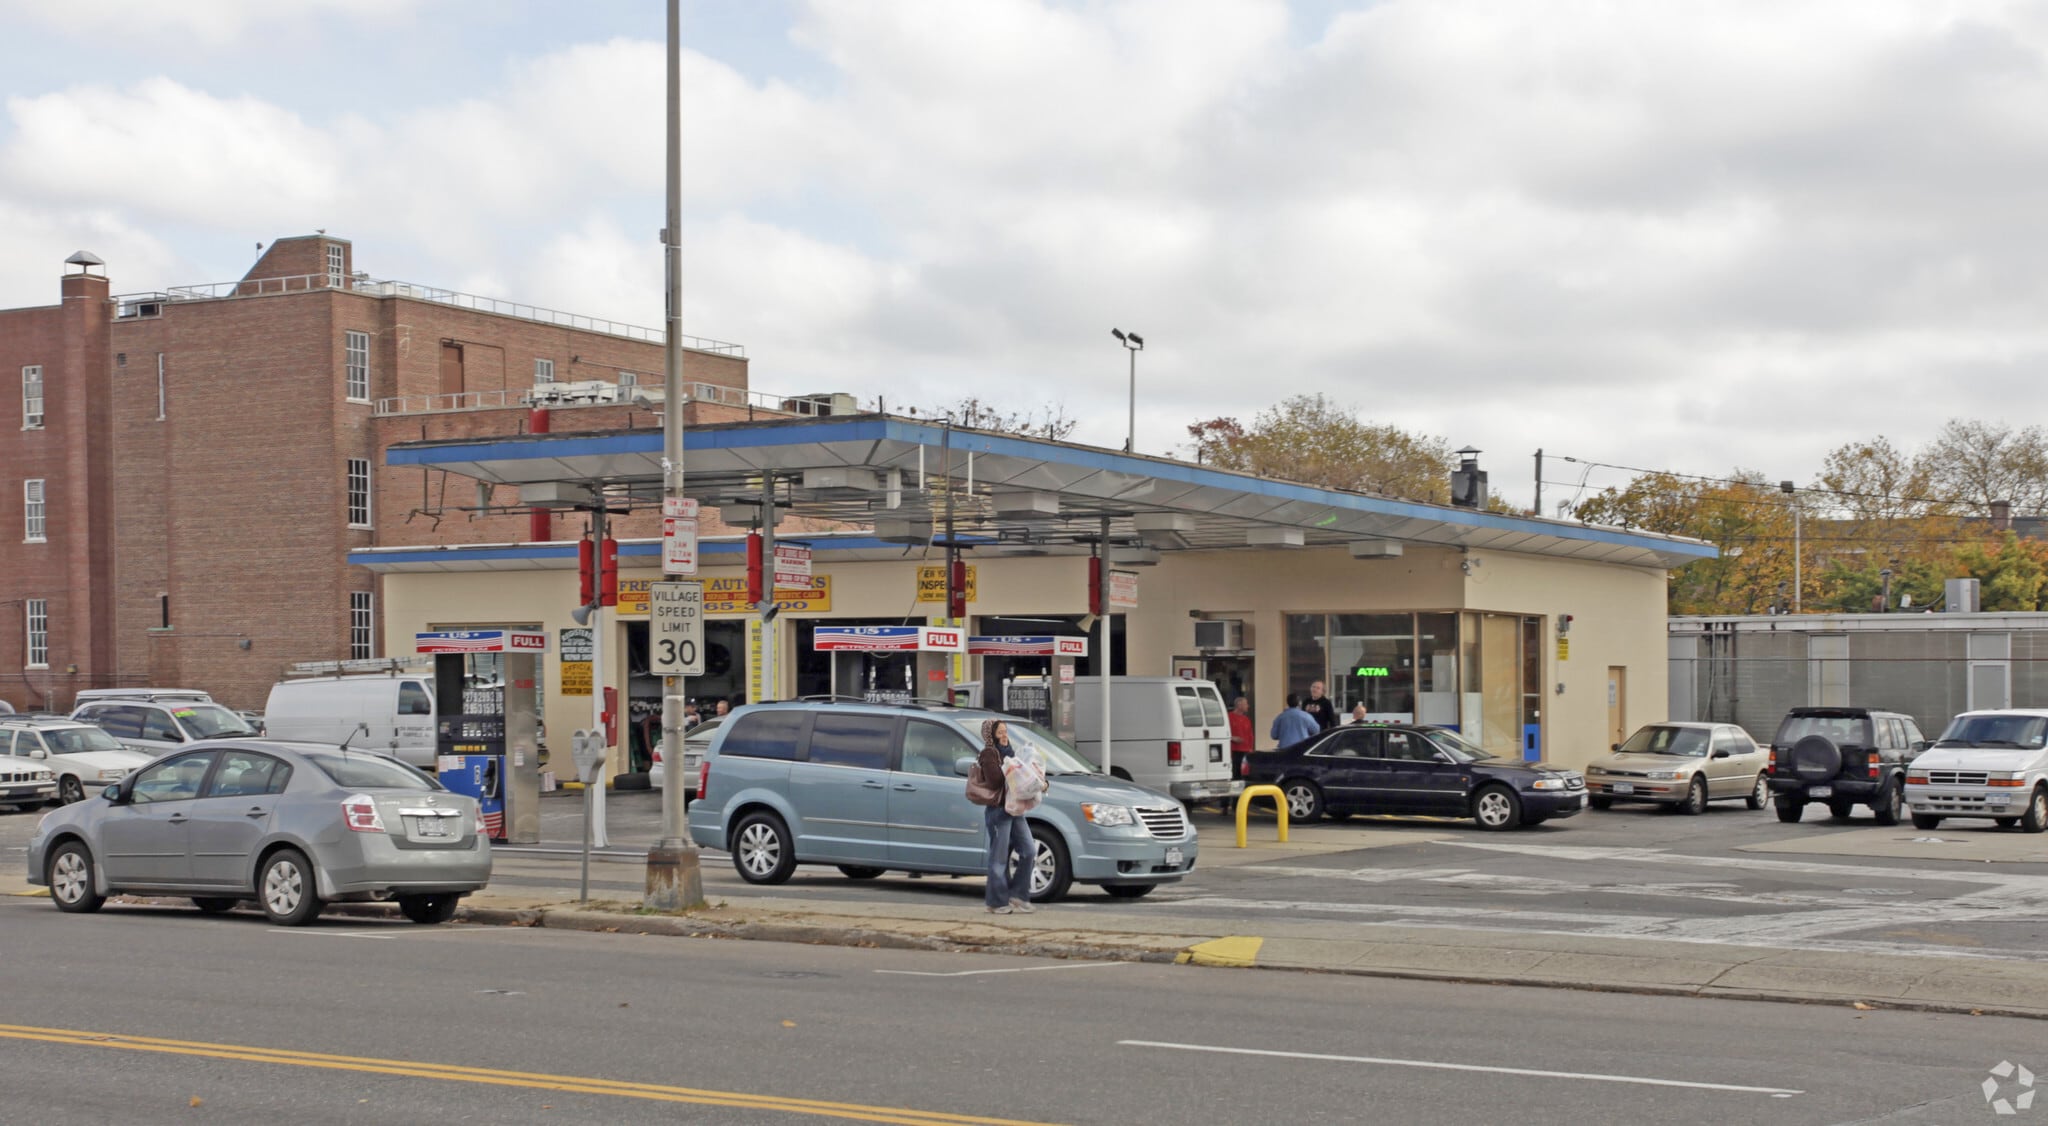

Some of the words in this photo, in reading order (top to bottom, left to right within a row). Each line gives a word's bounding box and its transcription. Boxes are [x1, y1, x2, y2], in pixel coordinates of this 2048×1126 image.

[711, 579, 748, 591] AUT
[654, 591, 700, 602] VILLAGE
[657, 606, 695, 617] SPEED
[662, 622, 691, 632] LIMIT
[853, 627, 880, 635] US
[448, 631, 471, 639] US
[928, 634, 957, 645] FULL
[513, 636, 543, 647] FULL
[1061, 642, 1082, 652] FULL
[658, 639, 696, 665] 30
[1356, 667, 1389, 676] ATM
